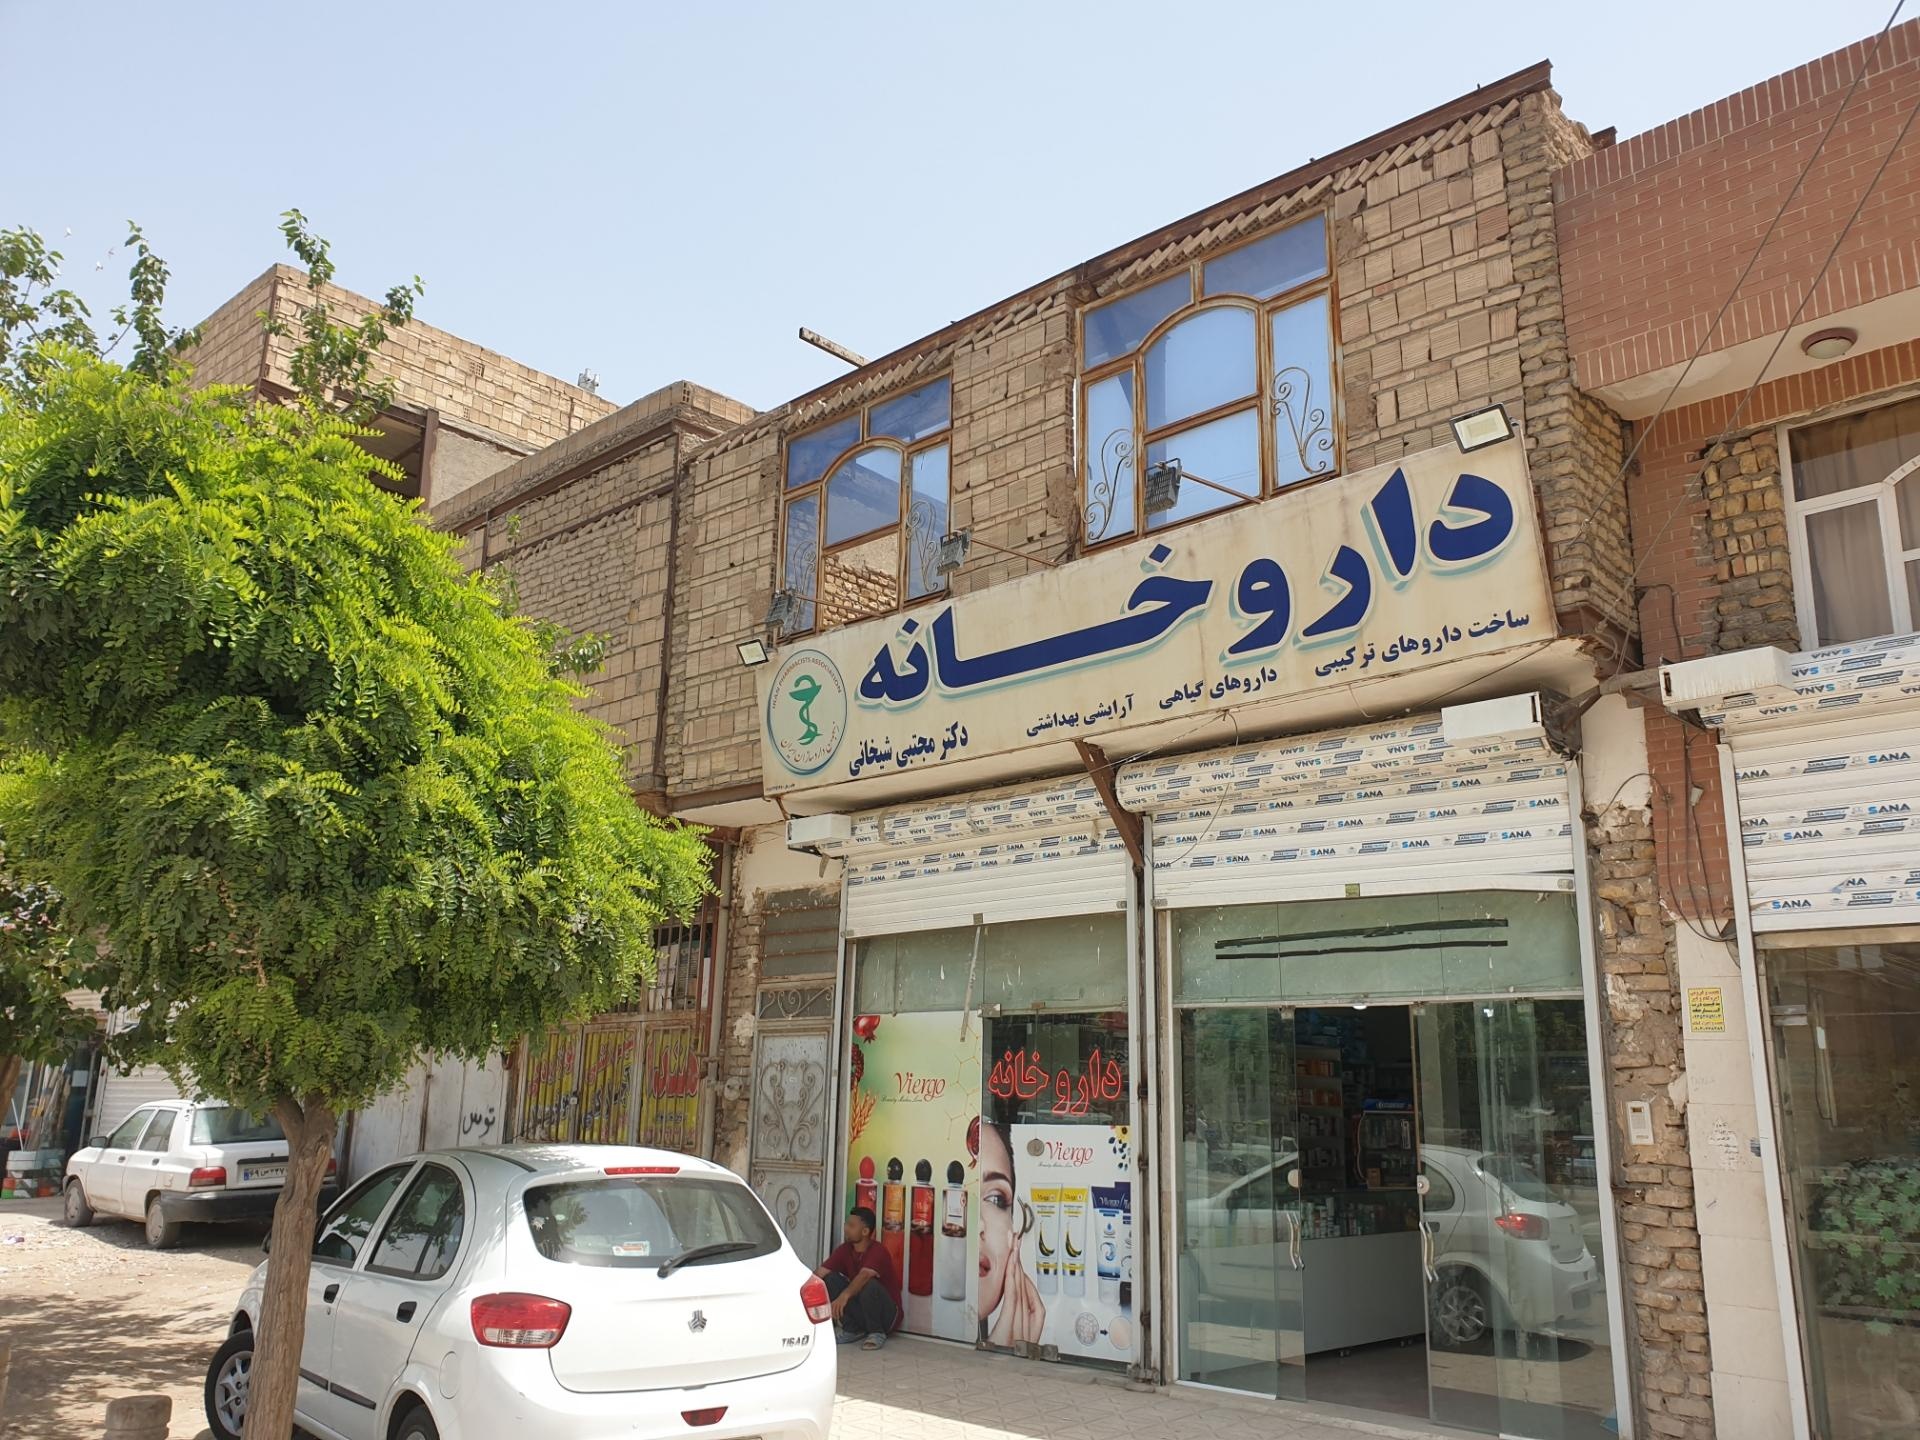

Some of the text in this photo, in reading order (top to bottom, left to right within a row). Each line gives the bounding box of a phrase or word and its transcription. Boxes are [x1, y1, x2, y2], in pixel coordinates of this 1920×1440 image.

[1315, 609, 1529, 677] ساخت داروهای ترکیبی
[1811, 647, 1852, 660] SANA
[1159, 666, 1278, 710] داروهای گیاهی
[1794, 683, 1835, 696] SANA
[1026, 693, 1134, 737] آرایشی بهداشتی
[1759, 705, 1798, 716] SANA
[940, 720, 969, 760] دکتر
[1369, 731, 1397, 742] SANA
[896, 734, 936, 768] مجتبی
[1279, 746, 1305, 756] SANA
[1386, 743, 1416, 754] SANA
[1469, 745, 1501, 755] SANA
[1868, 751, 1911, 764] SANA
[1197, 759, 1221, 769] SANA
[1295, 758, 1322, 768] SANA
[1371, 759, 1400, 769] SANA
[1122, 772, 1144, 781] SANA
[1281, 773, 1308, 782] SANA
[1135, 783, 1157, 793] SANA
[1451, 778, 1481, 789] SANA
[1200, 785, 1224, 794] SANA
[1356, 789, 1384, 799] SANA
[1046, 794, 1065, 802] SANA
[1528, 797, 1560, 808] SANA
[983, 804, 1001, 812] SANA
[1268, 800, 1294, 810] SANA
[1868, 803, 1911, 815] SANA
[1028, 809, 1047, 817] SANA
[1188, 809, 1212, 818] SANA
[1429, 808, 1457, 819] SANA
[1337, 818, 1364, 828] SANA
[1252, 827, 1277, 836] SANA
[1501, 830, 1532, 840] SANA
[1783, 829, 1823, 840] SANA
[1068, 834, 1088, 842] SANA
[1175, 834, 1198, 844] SANA
[1401, 839, 1430, 849] SANA
[948, 851, 966, 859] SANA
[1310, 847, 1336, 857] SANA
[894, 860, 911, 868] SANA
[980, 859, 998, 867] SANA
[1226, 855, 1250, 864] SANA
[923, 867, 940, 875] SANA
[1771, 899, 1812, 910] SANA
[895, 1071, 946, 1102] Viergo
[463, 1107, 496, 1138] توس
[1046, 1141, 1094, 1167] Viergo
